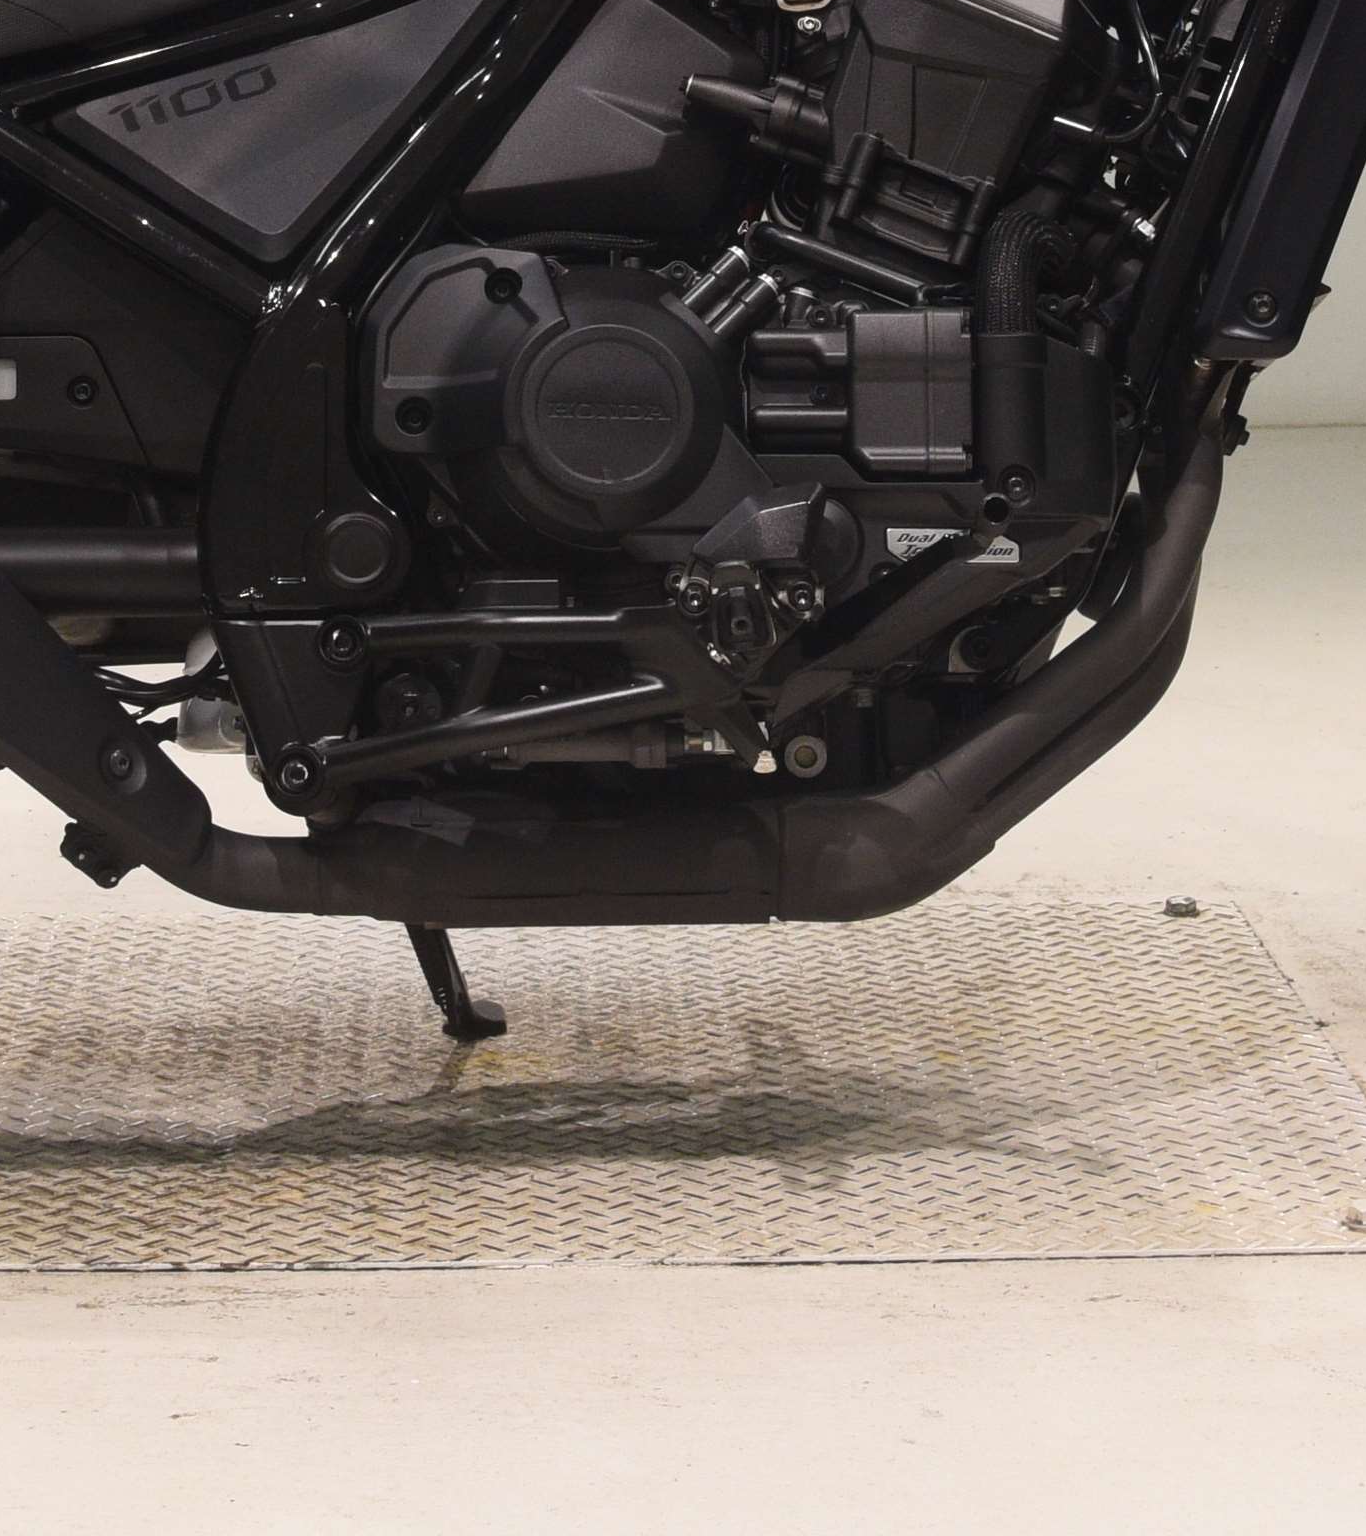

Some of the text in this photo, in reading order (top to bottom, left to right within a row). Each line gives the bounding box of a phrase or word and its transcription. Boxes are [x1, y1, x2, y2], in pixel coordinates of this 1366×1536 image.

[108, 64, 277, 133] 1100
[546, 400, 672, 421] HONDA
[897, 532, 936, 543] Dual
